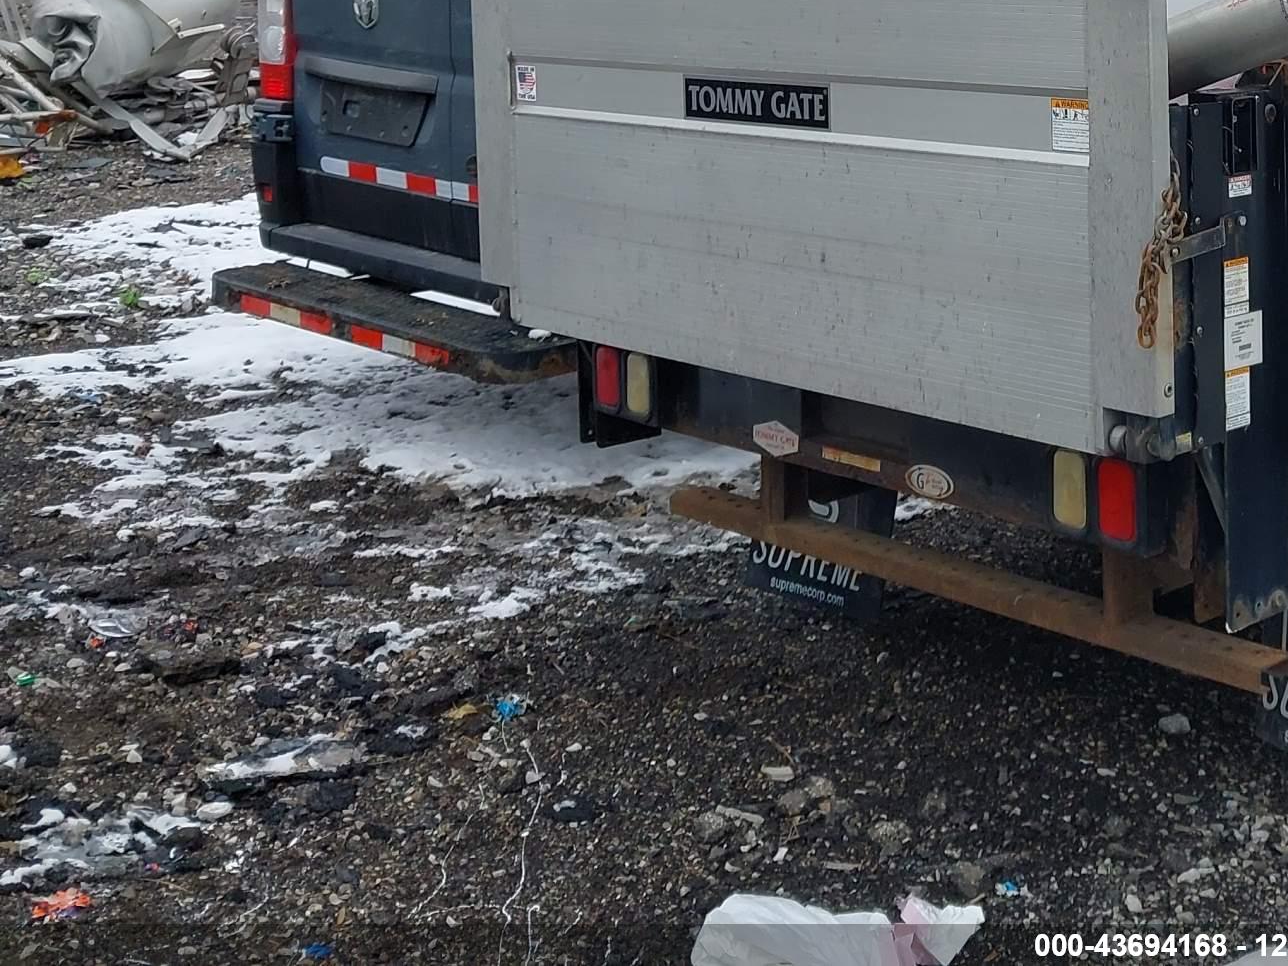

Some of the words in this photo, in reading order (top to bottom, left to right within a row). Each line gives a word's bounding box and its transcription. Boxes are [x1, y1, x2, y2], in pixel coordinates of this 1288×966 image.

[687, 85, 764, 116] TOMMY
[771, 90, 826, 121] GATE
[770, 576, 844, 607] supremecorp.com
